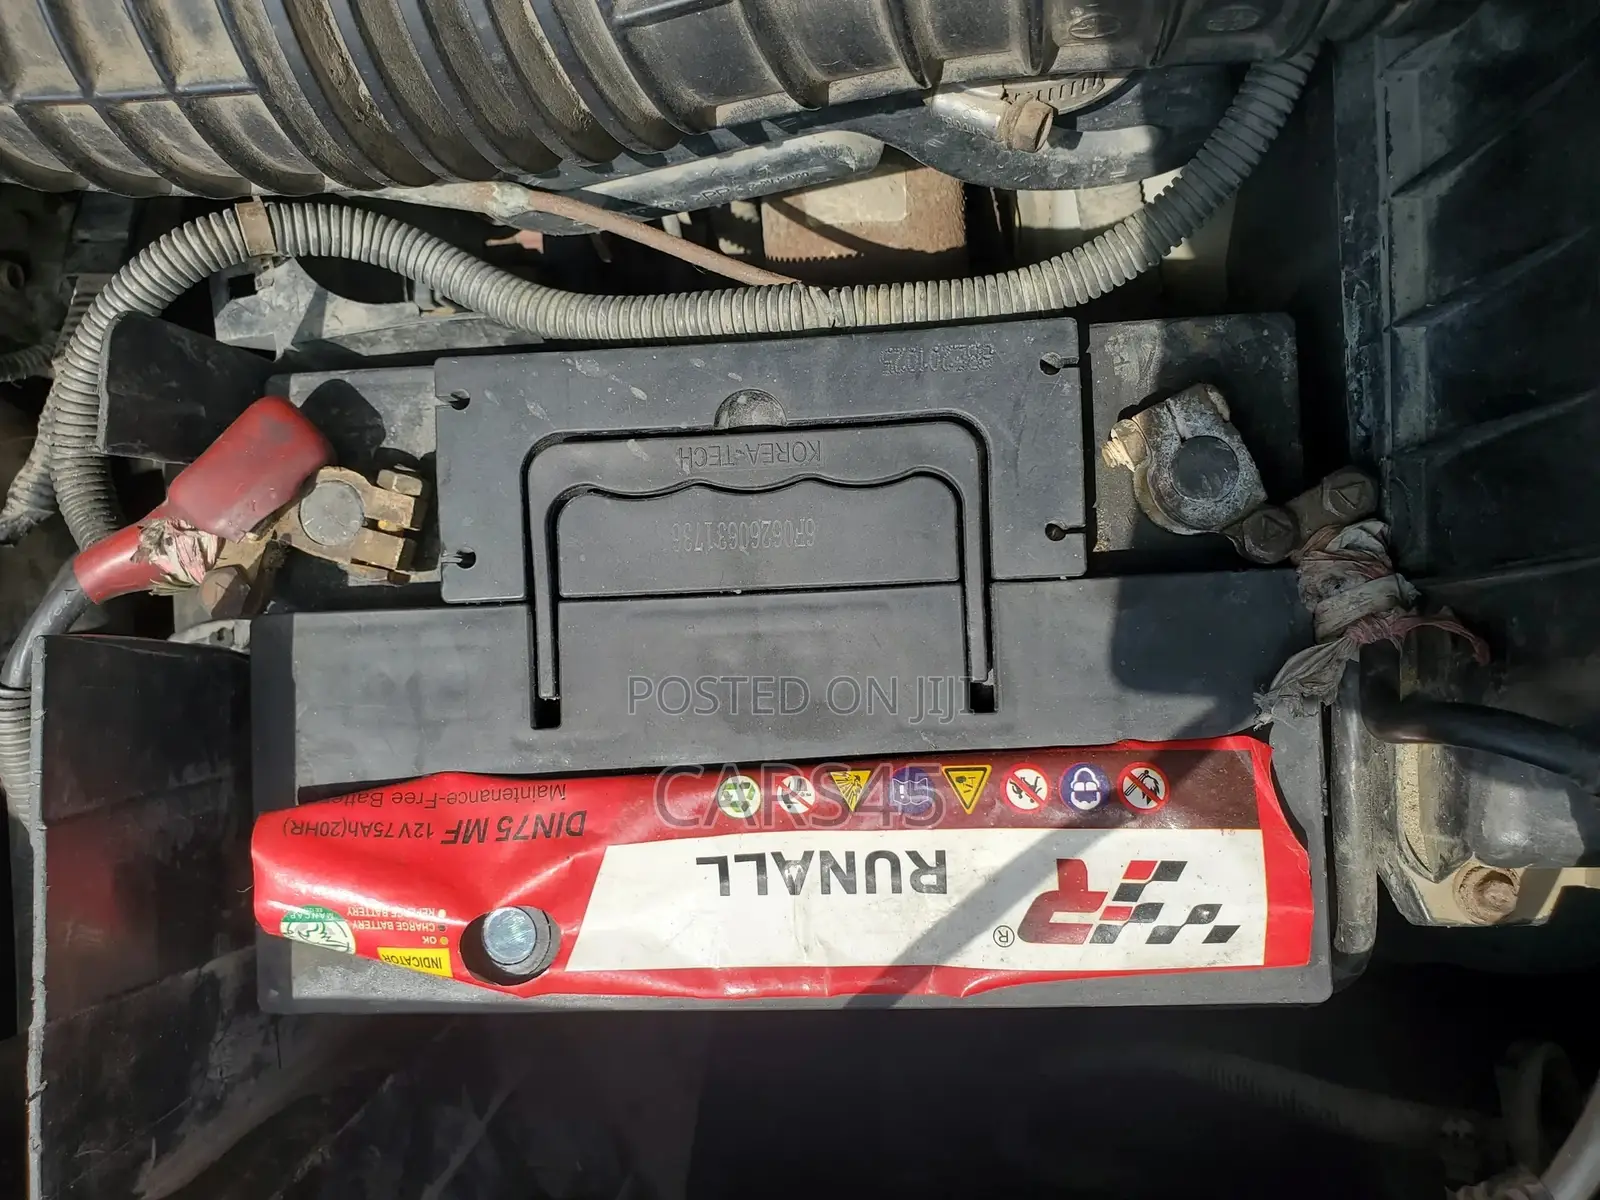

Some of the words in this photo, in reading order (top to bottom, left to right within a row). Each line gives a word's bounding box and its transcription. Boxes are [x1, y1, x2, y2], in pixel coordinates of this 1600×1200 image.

[391, 783, 566, 809] Maintenance-Free
[440, 817, 490, 845] MF
[496, 810, 587, 841] DIN75
[696, 850, 947, 897] RUNALL
[352, 920, 393, 931] BATTERY
[395, 922, 436, 932] CHARGE
[422, 936, 437, 944] OK
[382, 954, 442, 969] INDICATOR
